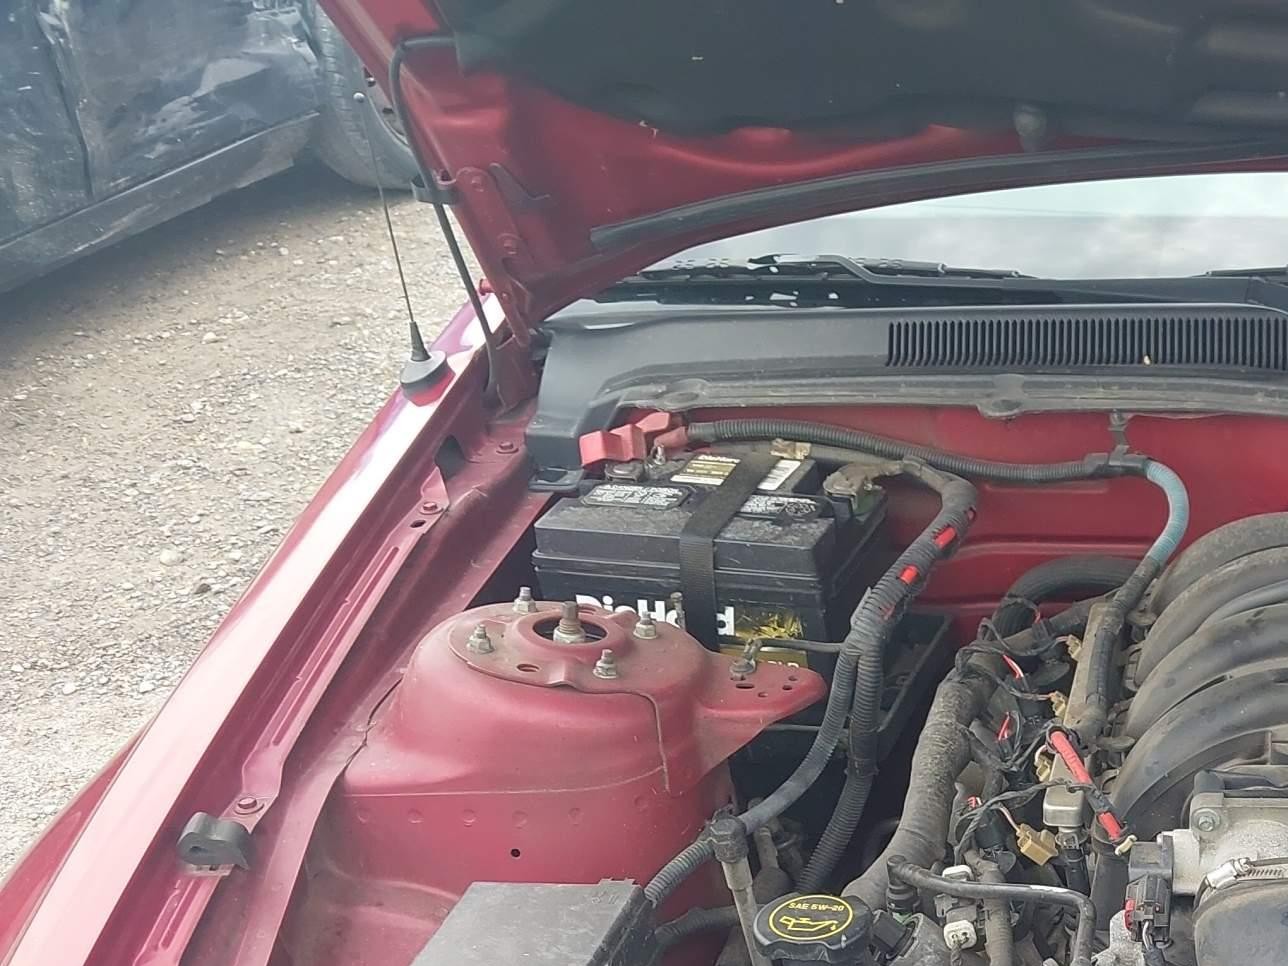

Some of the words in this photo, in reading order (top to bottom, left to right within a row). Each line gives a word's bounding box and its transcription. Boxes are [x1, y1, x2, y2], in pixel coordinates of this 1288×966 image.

[576, 594, 735, 636] DiHd
[788, 902, 809, 910] SAE
[811, 903, 845, 912] 5W-20
